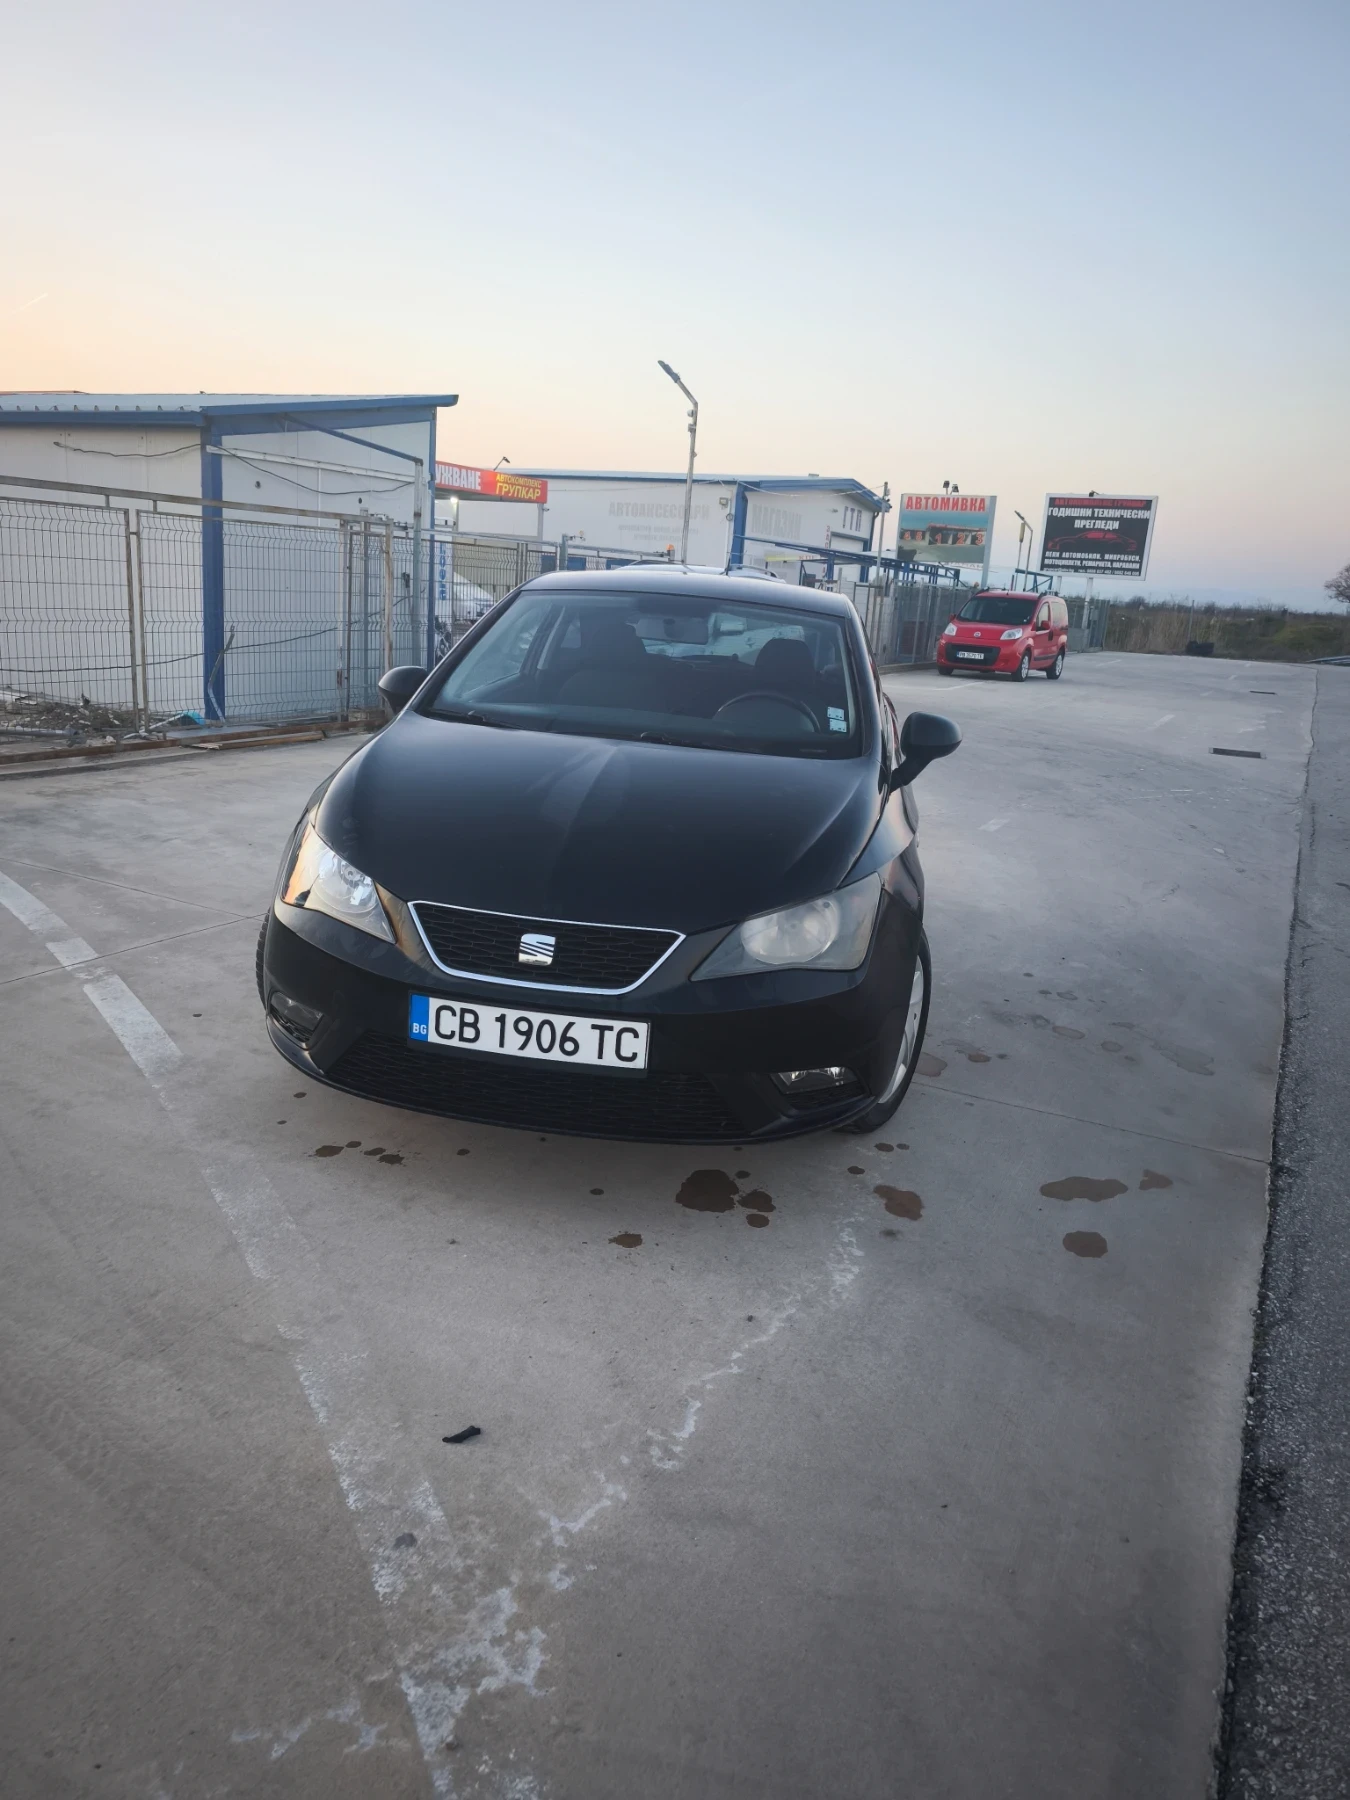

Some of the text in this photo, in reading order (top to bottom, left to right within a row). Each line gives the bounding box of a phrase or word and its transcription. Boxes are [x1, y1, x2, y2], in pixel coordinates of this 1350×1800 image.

[496, 473, 542, 488] АВТОКОМПЛЕКС
[496, 483, 541, 500] ГРУПКАР
[906, 496, 986, 512] АВТОМИВКА
[843, 505, 862, 532] ГТП
[1048, 507, 1151, 519] ГОДИШНИ ТЕХНИЧЕСКИ
[1074, 519, 1120, 530] ПРЕГЛЕДИ
[957, 532, 965, 545] 2
[975, 533, 983, 545] 3
[412, 1004, 640, 1063] BG CB 1906 TC
